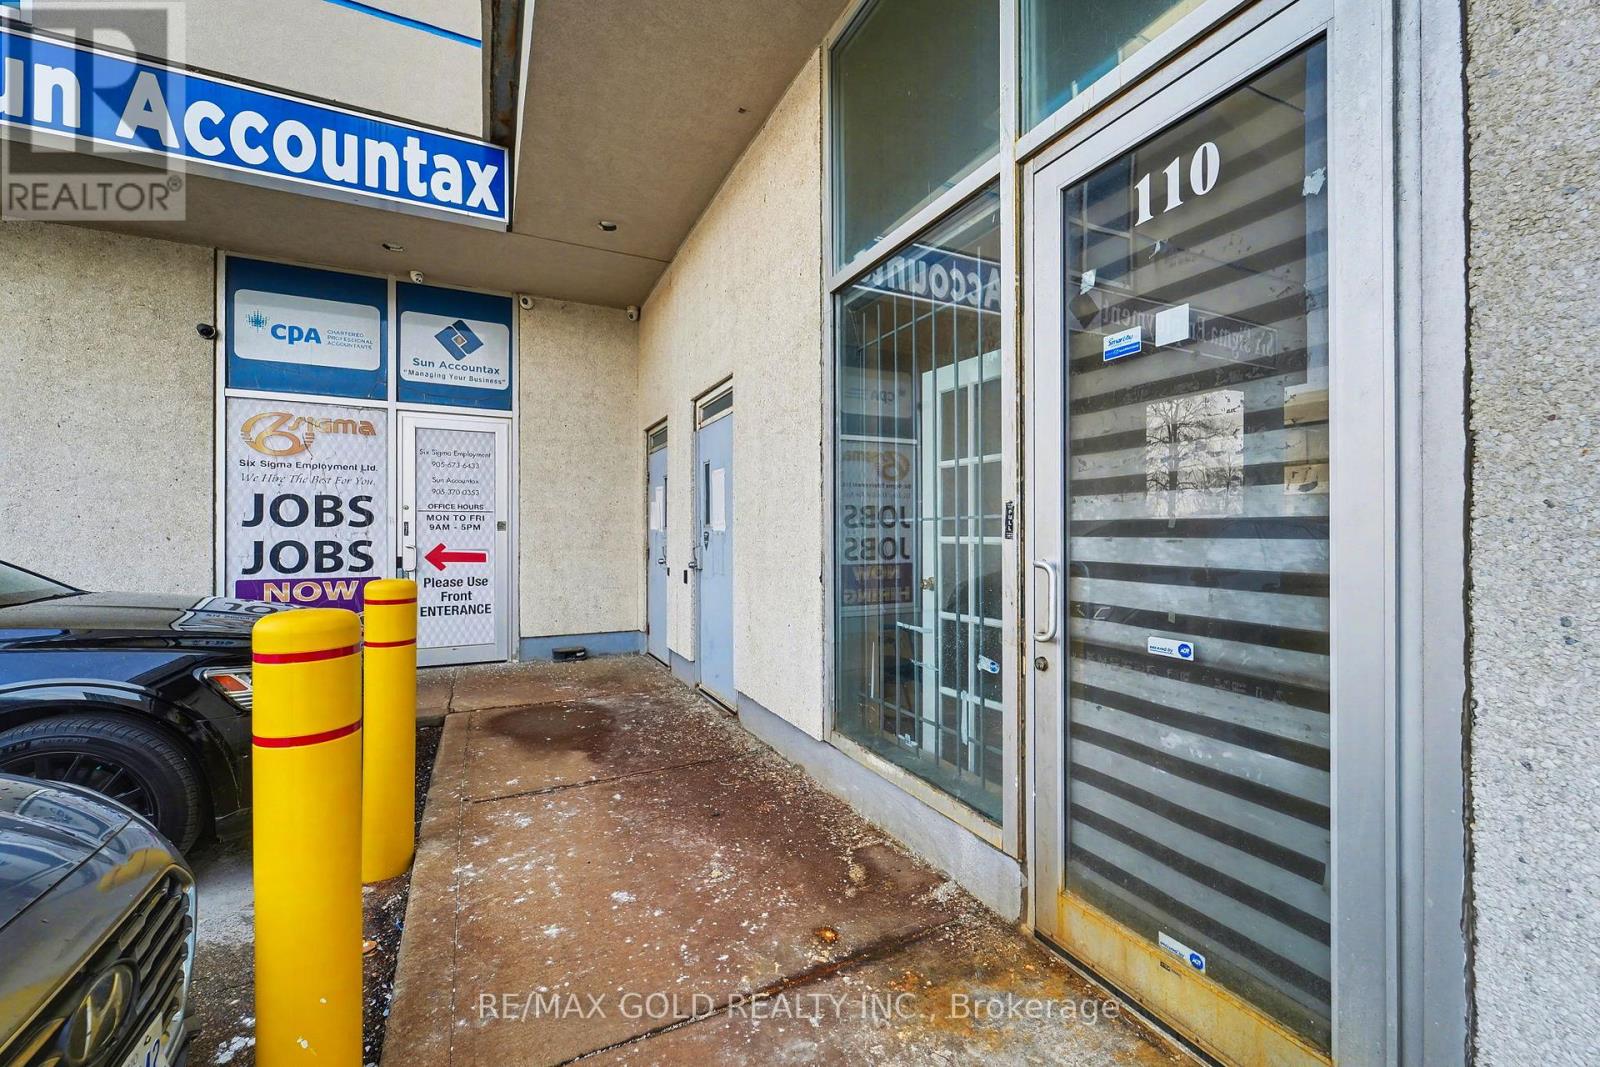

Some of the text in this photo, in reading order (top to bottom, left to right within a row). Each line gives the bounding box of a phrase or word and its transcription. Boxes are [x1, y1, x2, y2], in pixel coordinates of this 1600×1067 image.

[115, 71, 499, 212] Accountax
[1134, 141, 1221, 227] 110
[412, 357, 500, 375] Sun Accountax
[449, 374, 466, 382] Your
[431, 449, 452, 458] Sigma
[453, 450, 491, 459] Employment
[239, 459, 379, 472] Six Sigma Employment Ltd.
[241, 472, 259, 483] We
[262, 473, 287, 484] Hire
[290, 472, 307, 484] The
[311, 474, 332, 485] Best
[335, 475, 352, 485] For
[446, 477, 479, 485] Accountax
[241, 493, 375, 528] JOBS
[426, 514, 451, 522] MON
[241, 540, 375, 575] JOBS
[423, 576, 488, 588] Please Use
[263, 580, 360, 603] NOW
[440, 590, 472, 602] Front
[420, 603, 492, 617] ENTERANCE
